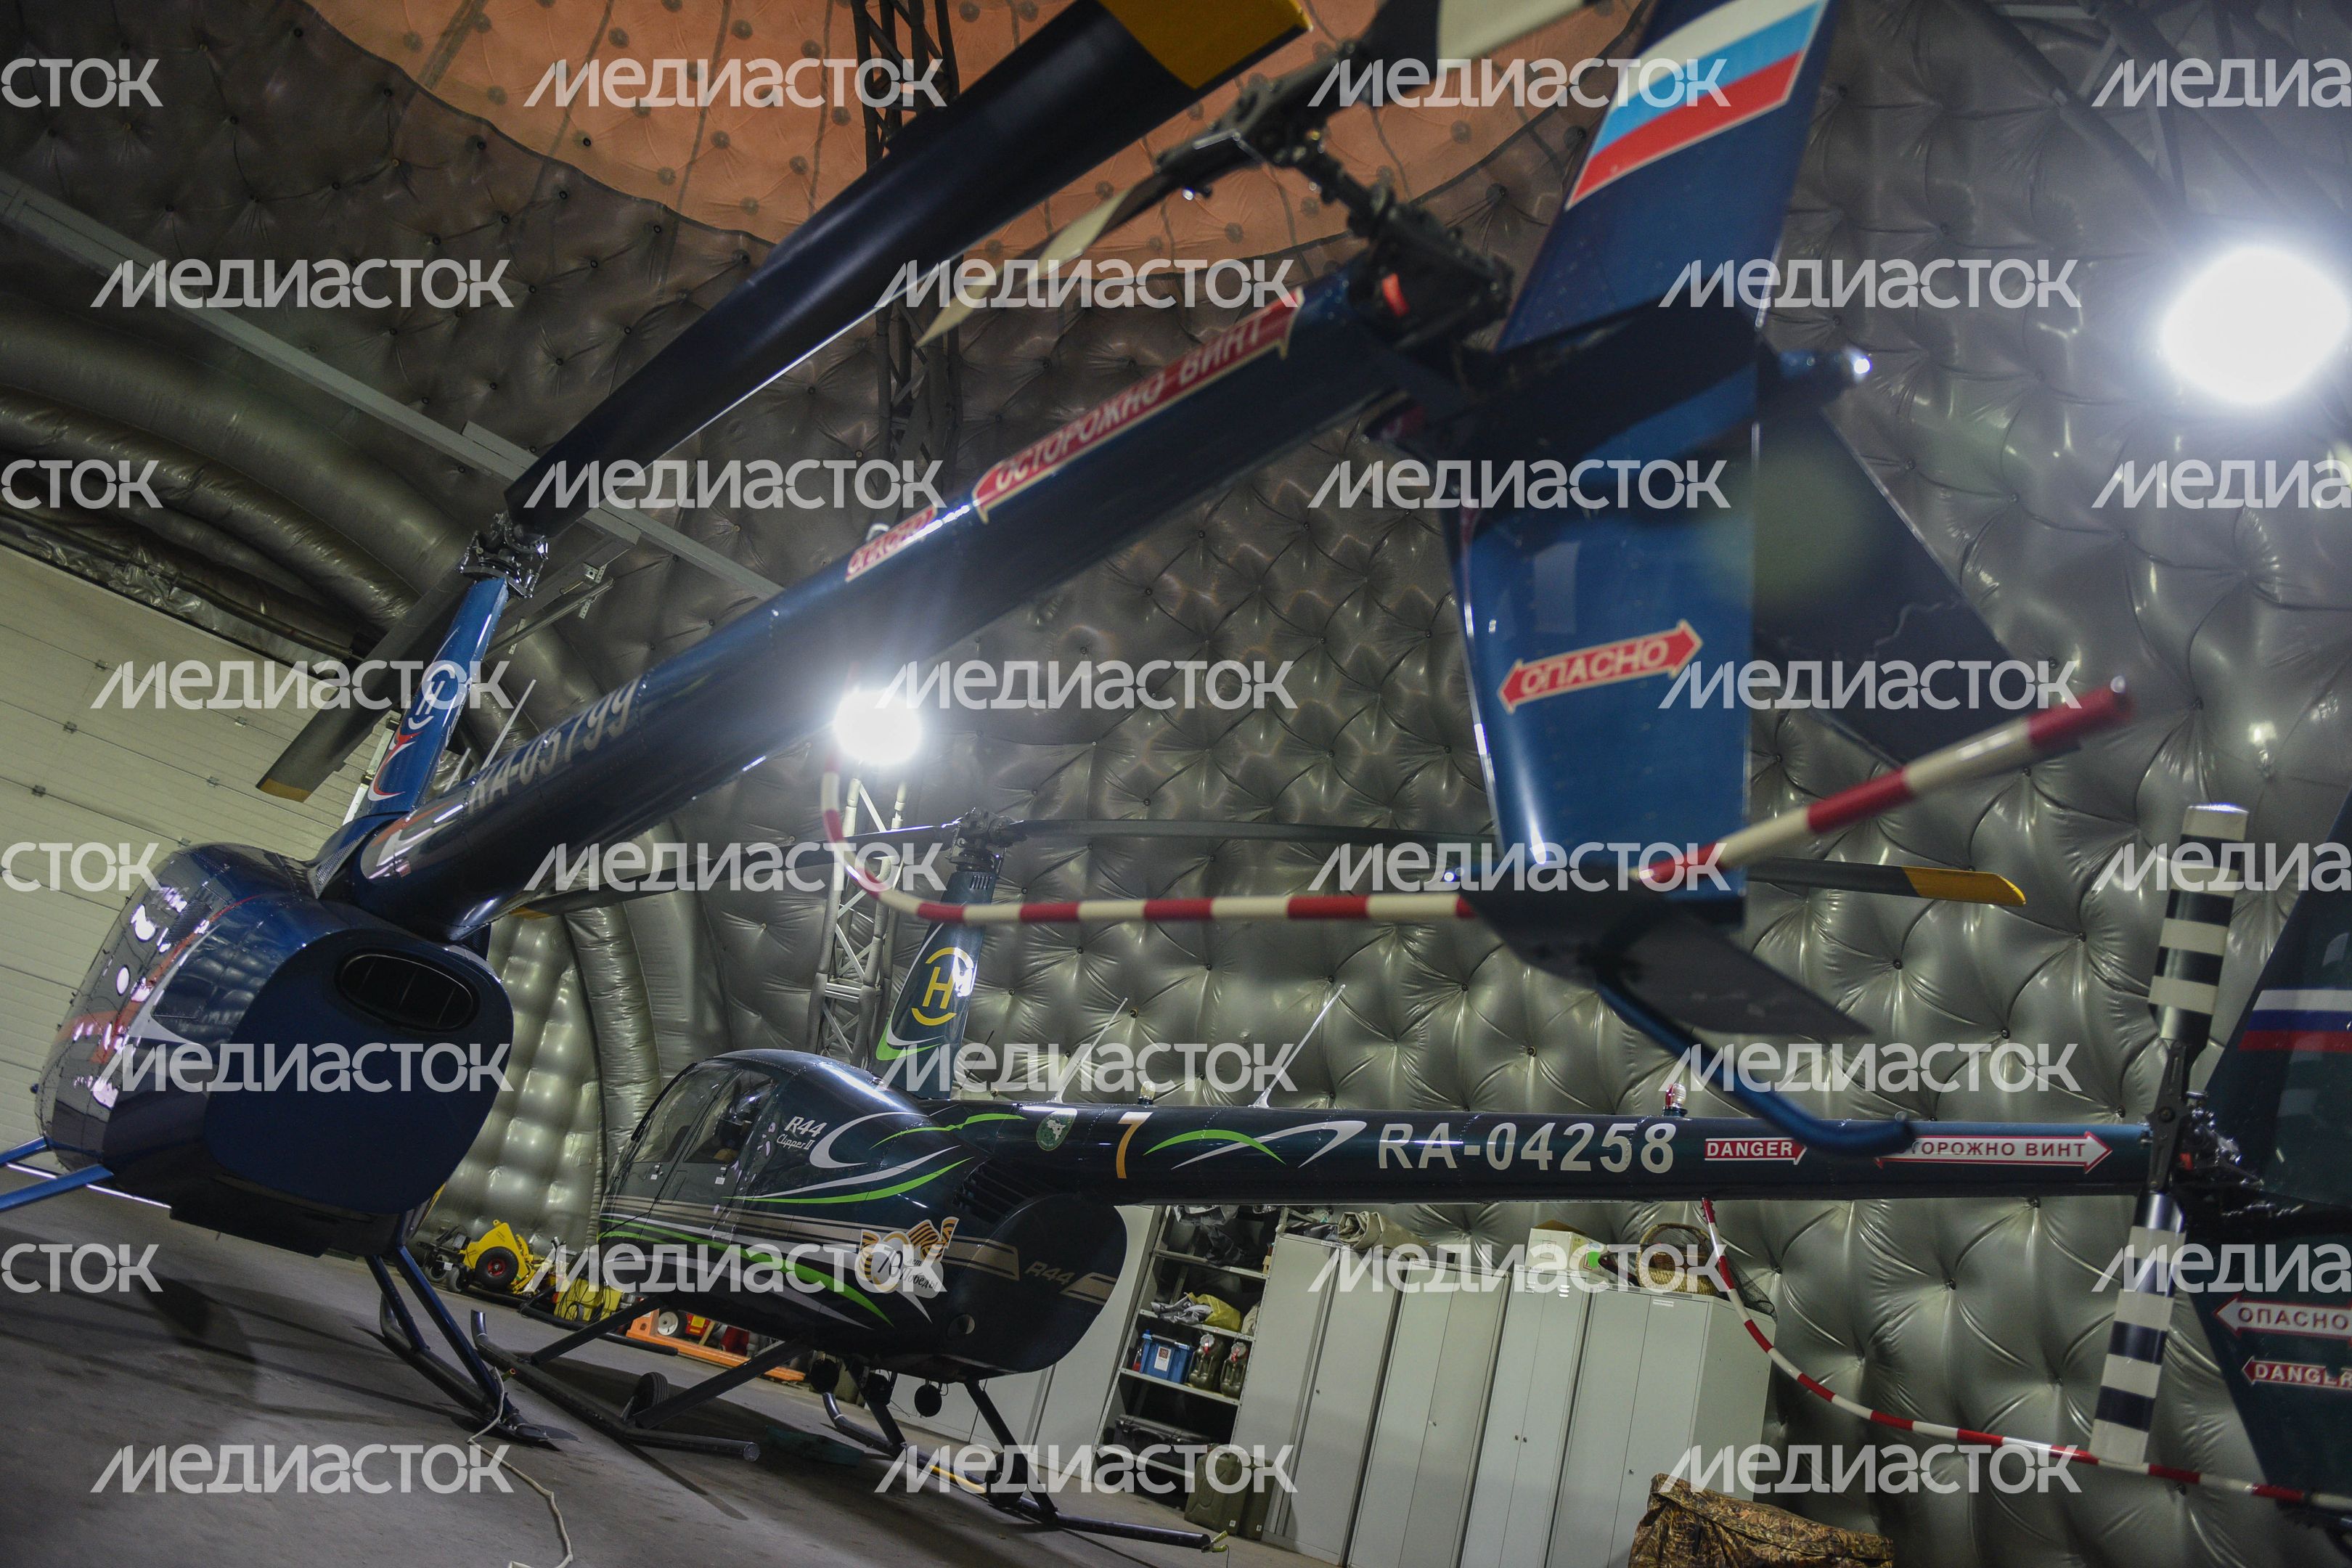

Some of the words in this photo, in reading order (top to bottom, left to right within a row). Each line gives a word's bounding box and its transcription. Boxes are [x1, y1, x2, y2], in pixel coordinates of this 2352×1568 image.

[995, 372, 1166, 491] ОСТОРОЖНО
[1179, 308, 1269, 385] ВИНТ
[1520, 637, 1670, 695] ОПАСНО
[784, 1115, 828, 1138] R44
[776, 1133, 807, 1149] Clipper
[1379, 1122, 1676, 1174] RA-04258
[1706, 1141, 1793, 1157] DANGER
[2025, 1142, 2086, 1158] ВИНТ
[1024, 1260, 1076, 1286] R44
[2238, 1307, 2349, 1331] ОПАСНО
